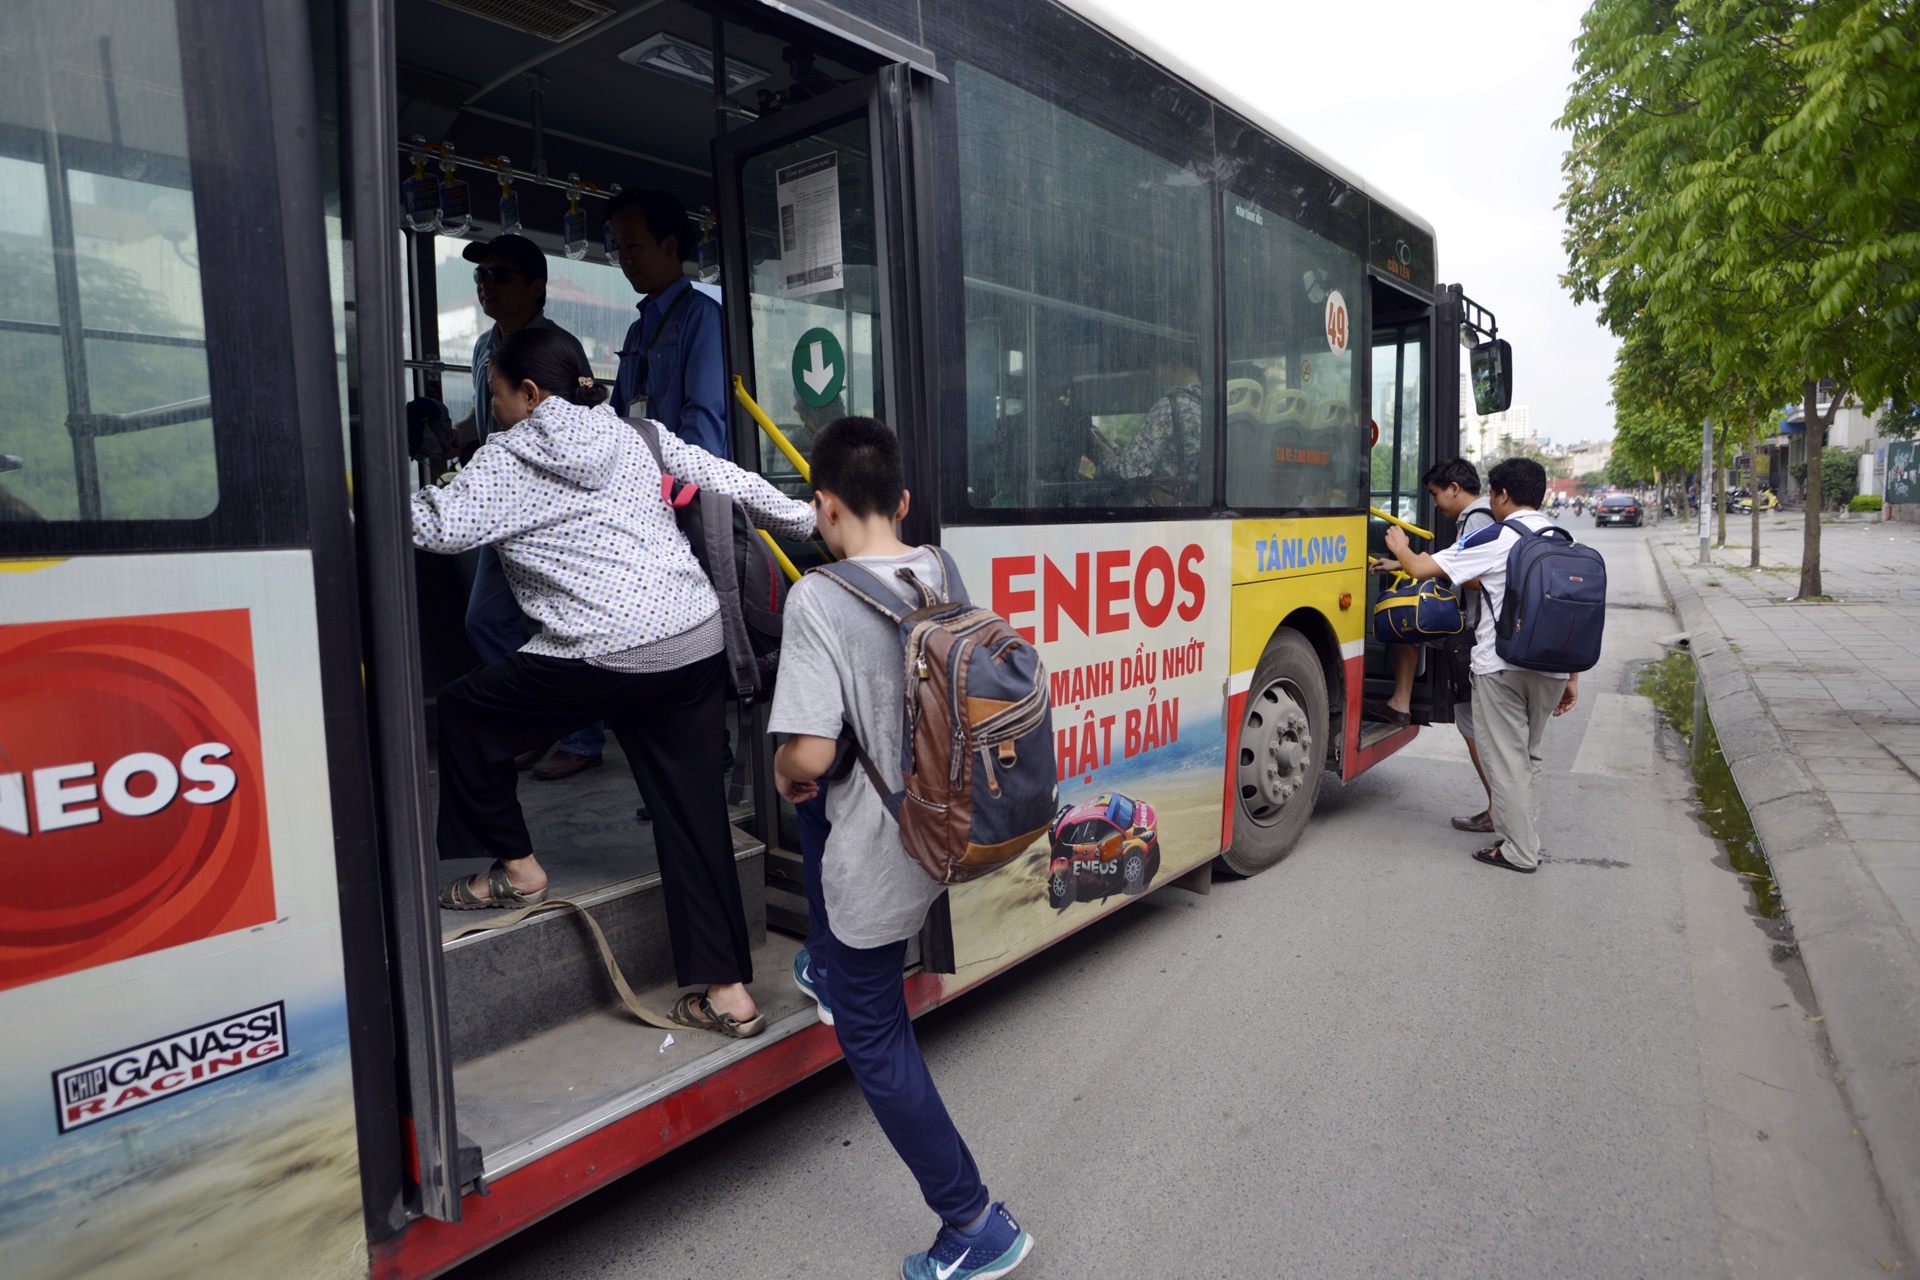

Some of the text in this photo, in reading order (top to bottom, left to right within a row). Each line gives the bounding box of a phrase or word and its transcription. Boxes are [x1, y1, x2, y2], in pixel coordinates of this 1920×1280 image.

[1328, 302, 1345, 348] 49
[991, 543, 1206, 646] ENEOS
[1050, 637, 1205, 711] MẠNH DẦU NHỚT
[1052, 686, 1179, 785] HẬT BẢN
[1073, 859, 1118, 876] ENEOS
[66, 1010, 278, 1103] CHIP GANASSI
[67, 1040, 280, 1113] RACING
